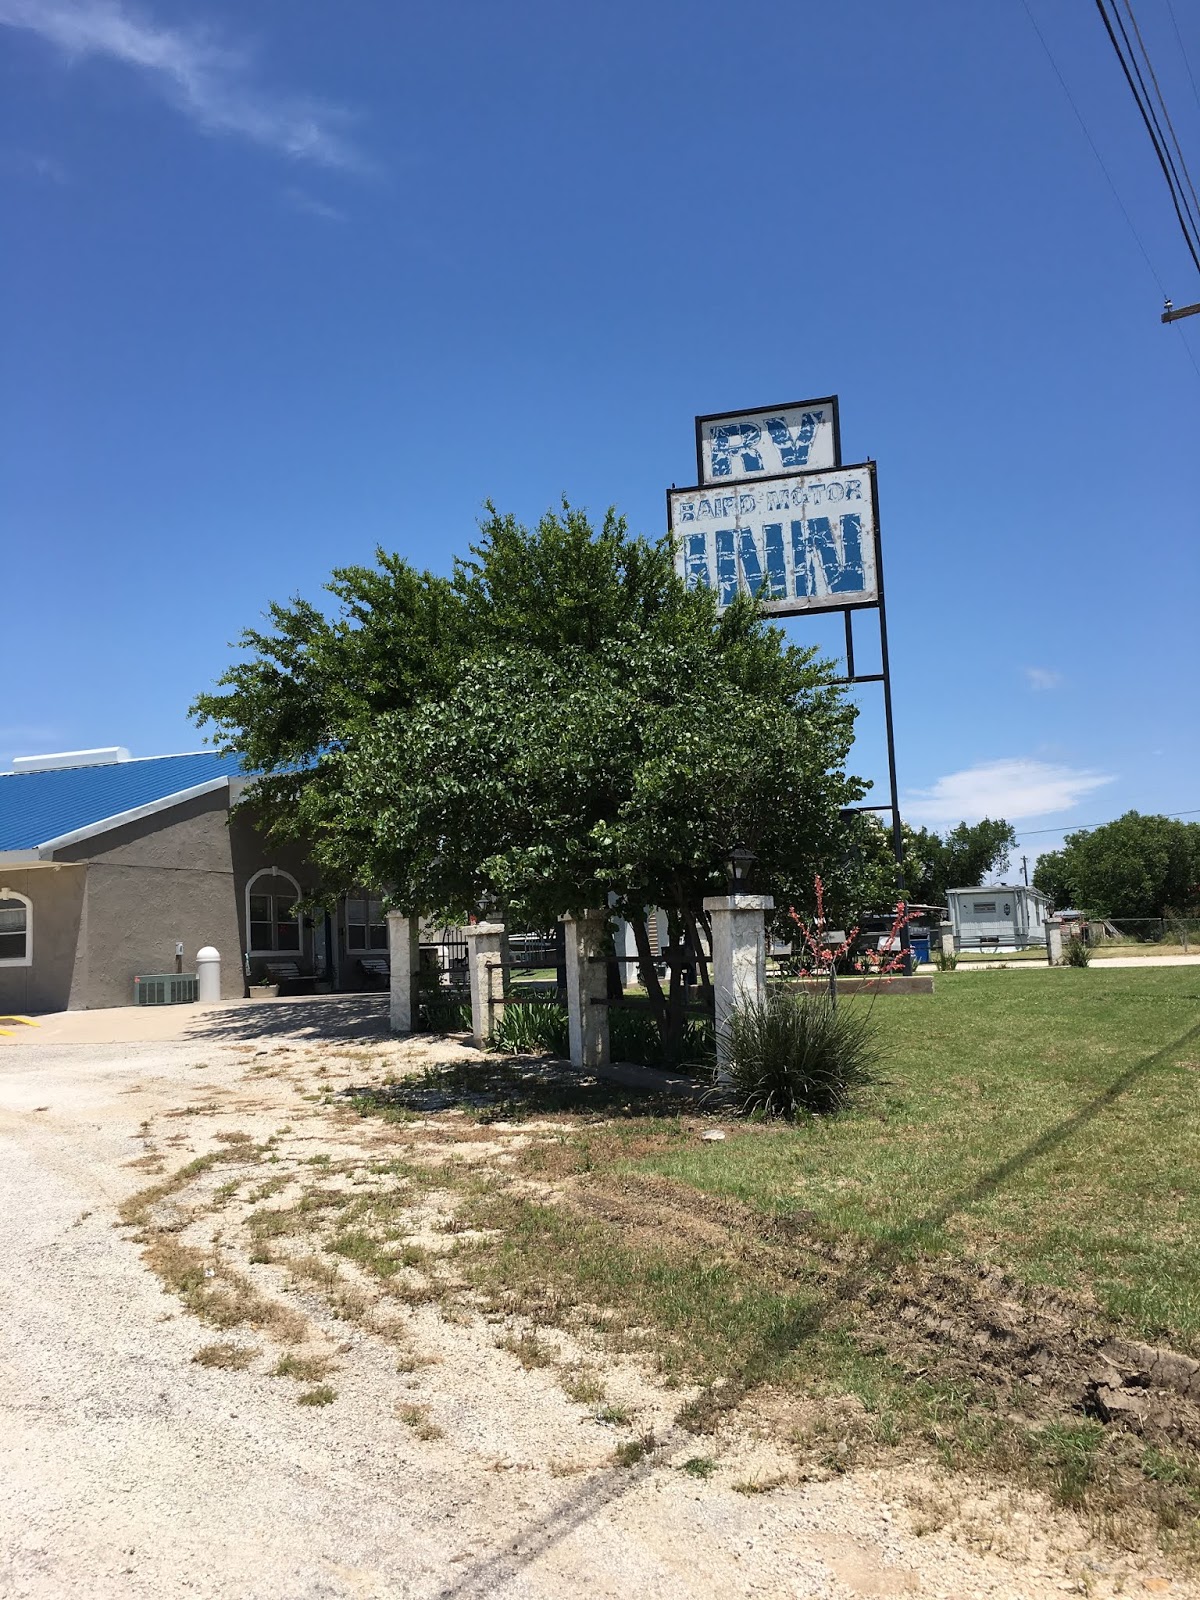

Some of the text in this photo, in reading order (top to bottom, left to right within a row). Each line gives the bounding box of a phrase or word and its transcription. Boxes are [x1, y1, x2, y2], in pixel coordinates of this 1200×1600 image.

[709, 410, 824, 477] RV
[679, 479, 862, 523] BAIRD MOTOR
[683, 513, 866, 607] INN
